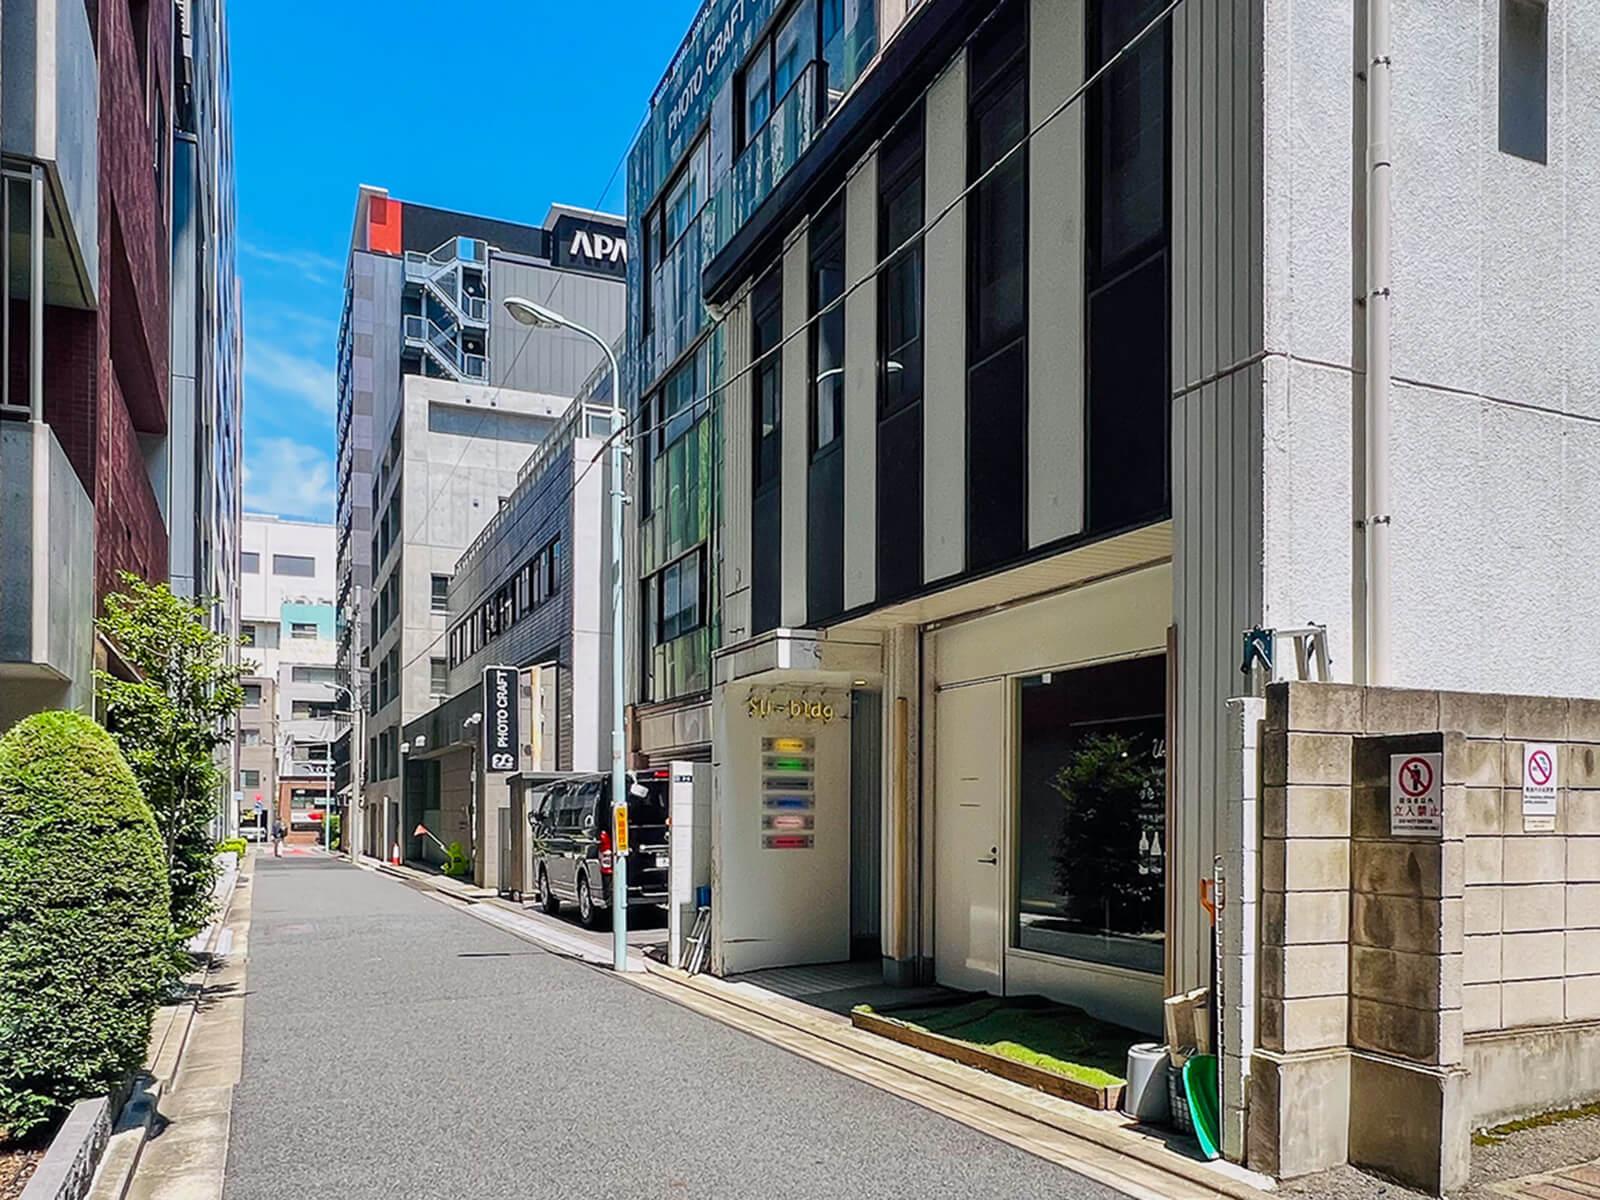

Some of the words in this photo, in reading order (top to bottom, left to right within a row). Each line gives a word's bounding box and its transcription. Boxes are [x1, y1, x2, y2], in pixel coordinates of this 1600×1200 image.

[668, 65, 703, 139] PHOTO
[496, 670, 508, 708] CRAFT
[496, 709, 509, 748] PHOTO
[1393, 805, 1440, 817] 立入禁止
